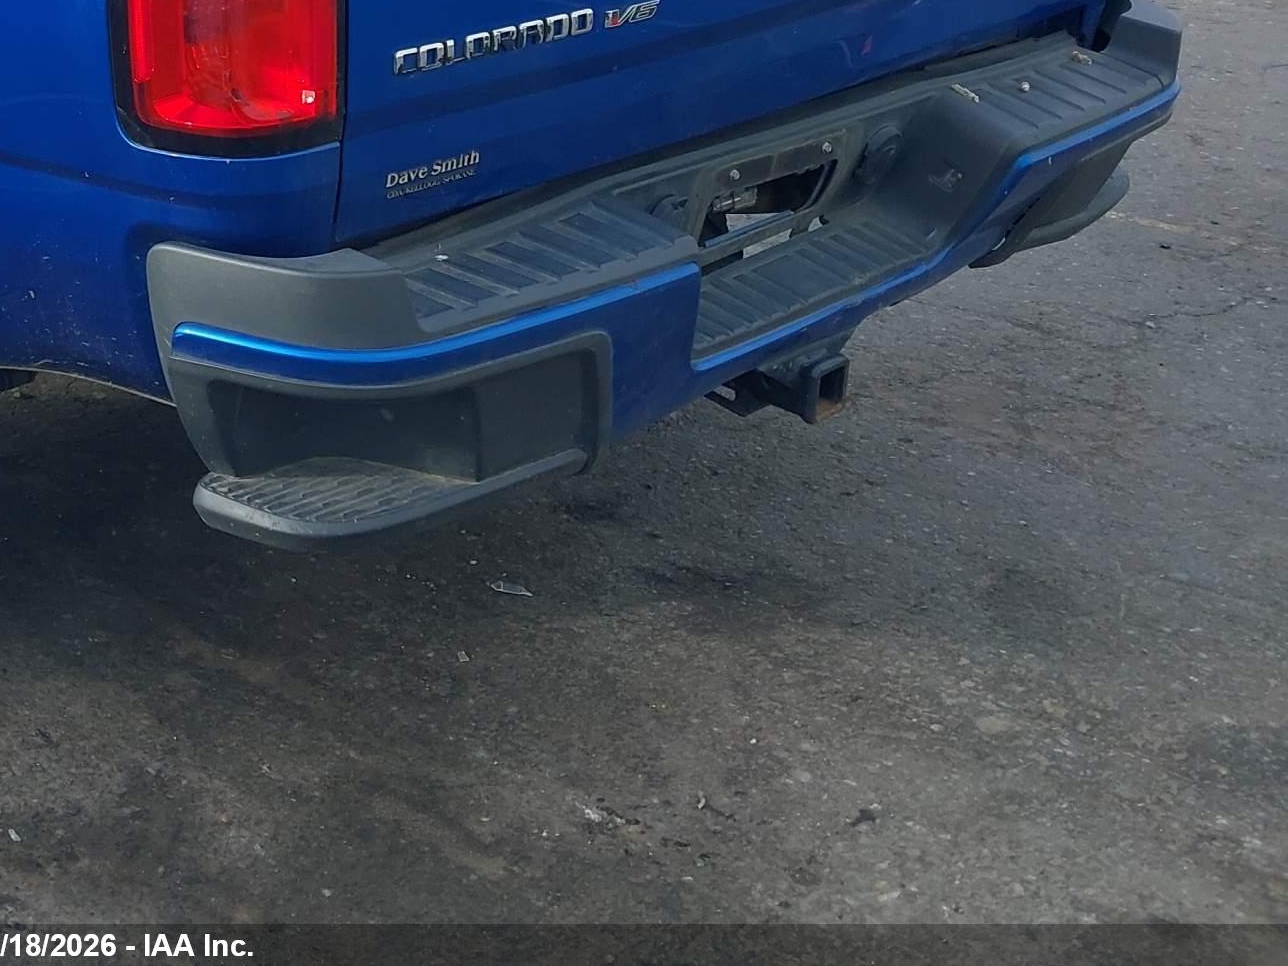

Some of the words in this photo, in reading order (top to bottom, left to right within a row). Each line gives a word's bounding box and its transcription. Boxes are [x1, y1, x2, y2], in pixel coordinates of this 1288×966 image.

[393, 8, 594, 74] COLORADO
[605, 0, 660, 28] V6
[385, 166, 428, 188] Dave
[431, 149, 480, 176] Smith
